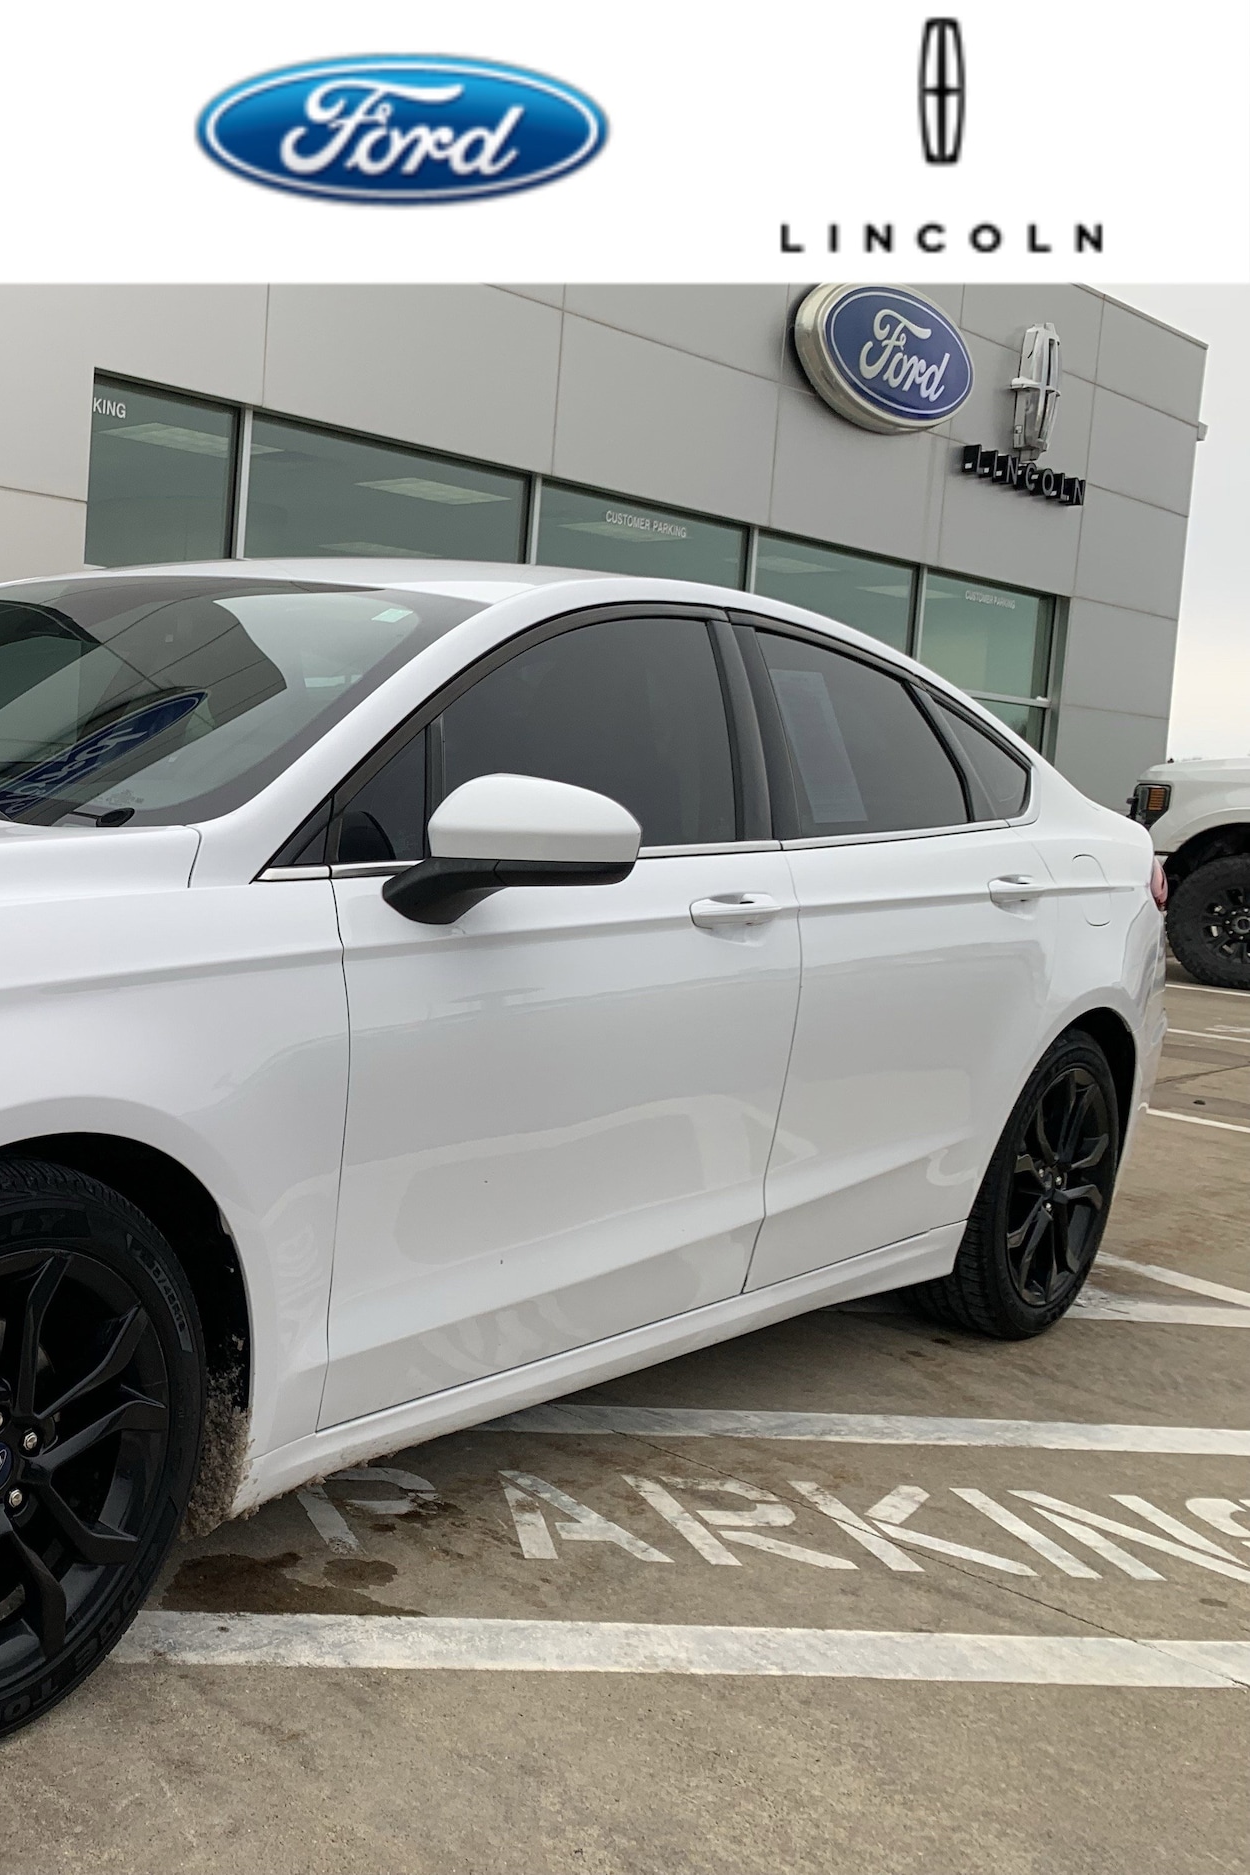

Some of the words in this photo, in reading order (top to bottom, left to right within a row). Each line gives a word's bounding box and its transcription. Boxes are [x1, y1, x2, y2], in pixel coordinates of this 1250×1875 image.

[859, 308, 950, 402] Ford
[962, 444, 1086, 506] LINCOLN
[605, 510, 650, 531] CUSTOMER
[653, 520, 687, 538] PARKING
